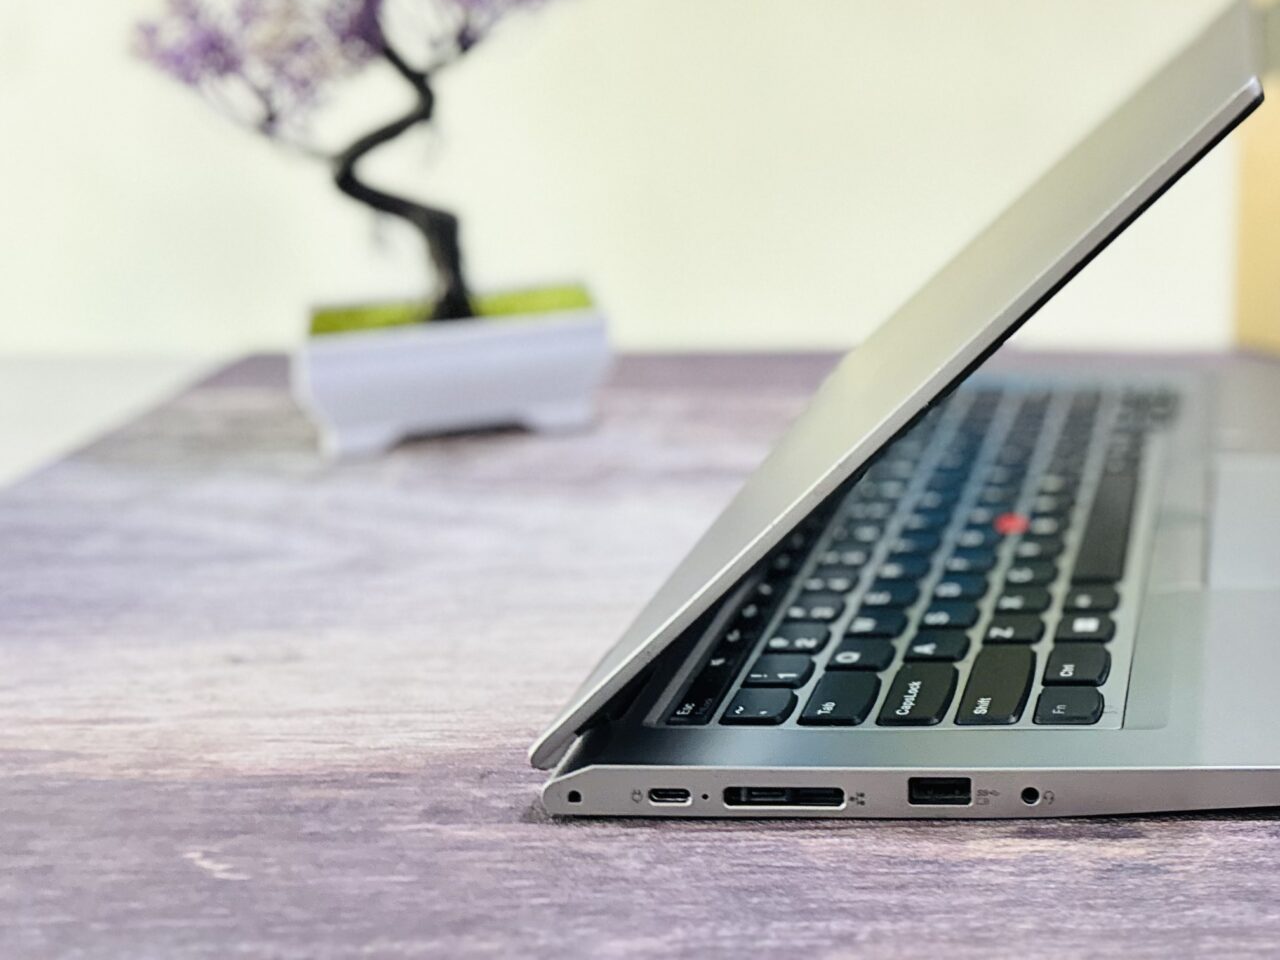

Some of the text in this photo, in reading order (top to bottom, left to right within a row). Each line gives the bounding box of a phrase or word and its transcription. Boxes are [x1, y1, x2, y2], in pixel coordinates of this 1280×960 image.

[989, 626, 1015, 639] Z
[794, 636, 818, 649] 2
[912, 642, 937, 656] A
[834, 650, 861, 664] Q
[1059, 663, 1076, 678] Ctrl
[896, 680, 923, 717] CapsLock
[676, 702, 696, 716] Esc
[816, 700, 837, 716] Tab
[973, 696, 993, 716] Shift
[1052, 703, 1068, 715] Fn
